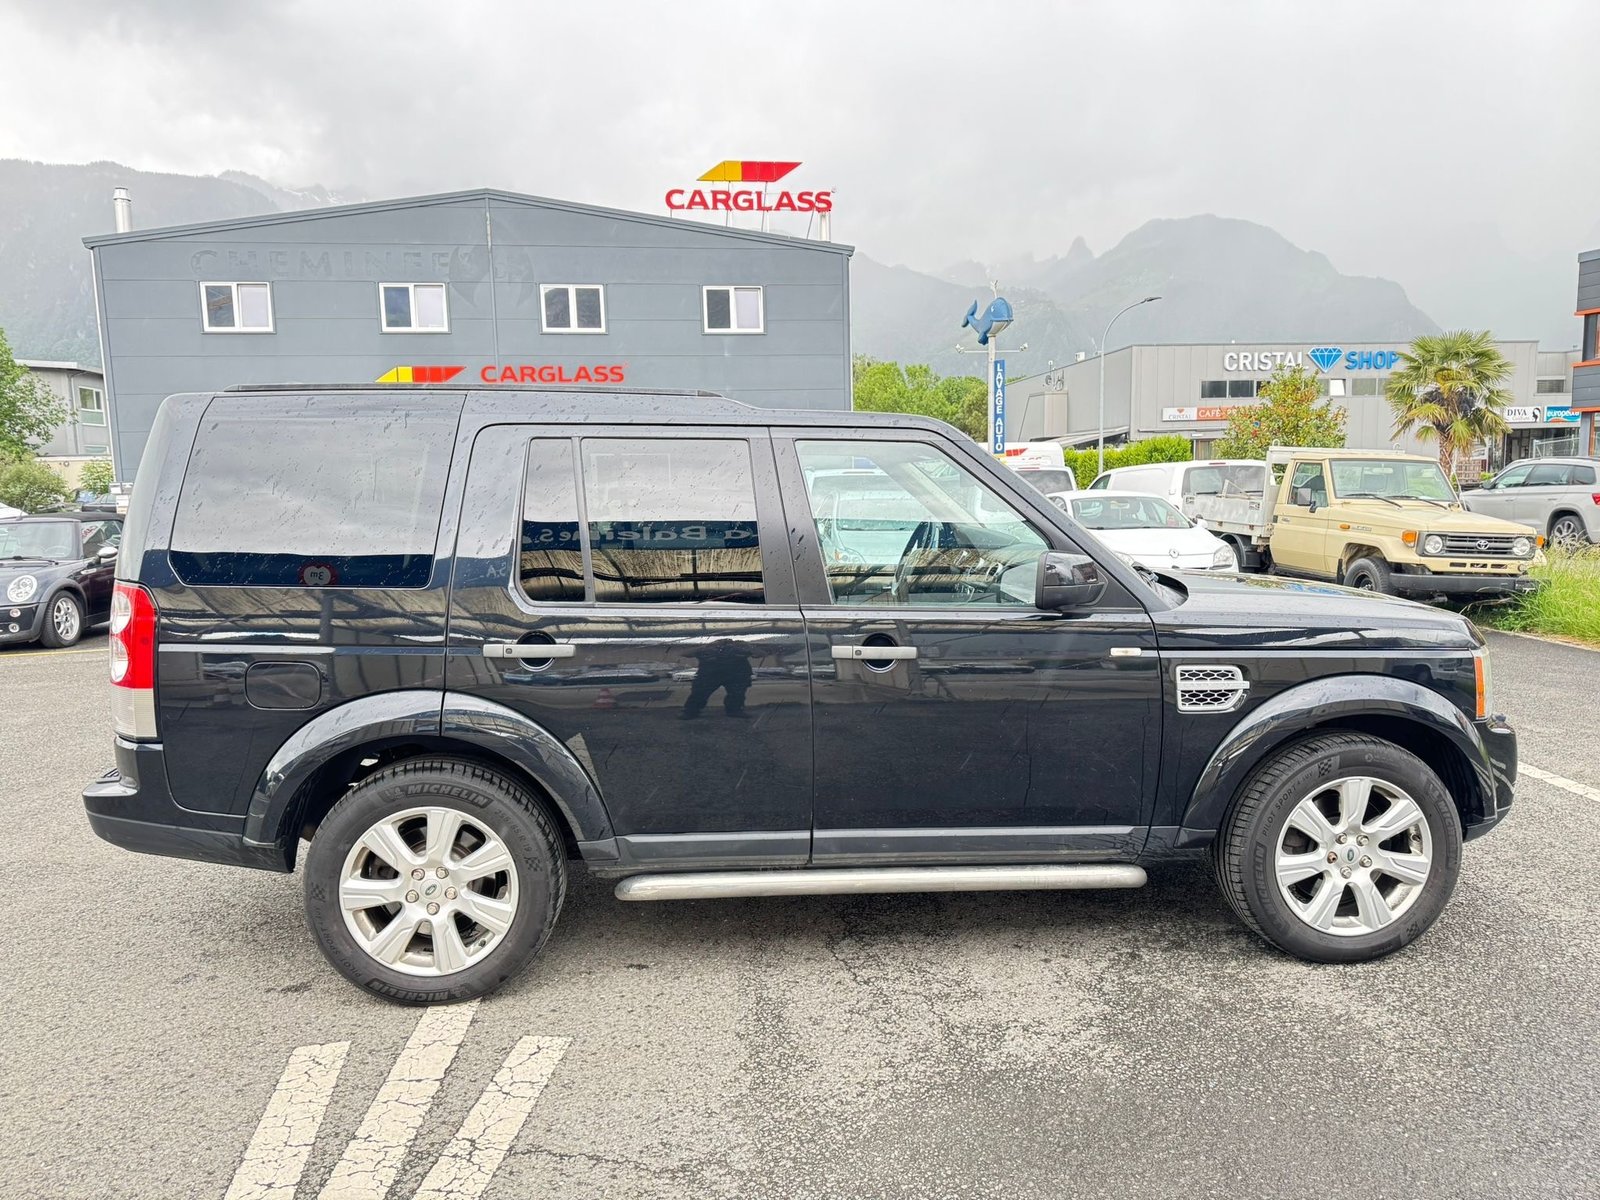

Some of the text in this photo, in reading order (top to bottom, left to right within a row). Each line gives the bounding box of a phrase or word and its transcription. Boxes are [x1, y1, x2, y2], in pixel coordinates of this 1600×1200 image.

[665, 189, 833, 212] CARGLASS
[1223, 351, 1401, 371] CRISTAL SHOP
[480, 366, 624, 383] CARGLASS
[995, 363, 1003, 451] LAVAGE AUTO
[1507, 408, 1527, 416] DIVA
[407, 783, 489, 808] MICHELIN
[1262, 811, 1277, 837] PILOT
[1276, 784, 1297, 810] SPORT
[1255, 846, 1276, 915] MICHELIN
[369, 979, 449, 1001] MICHELIN
